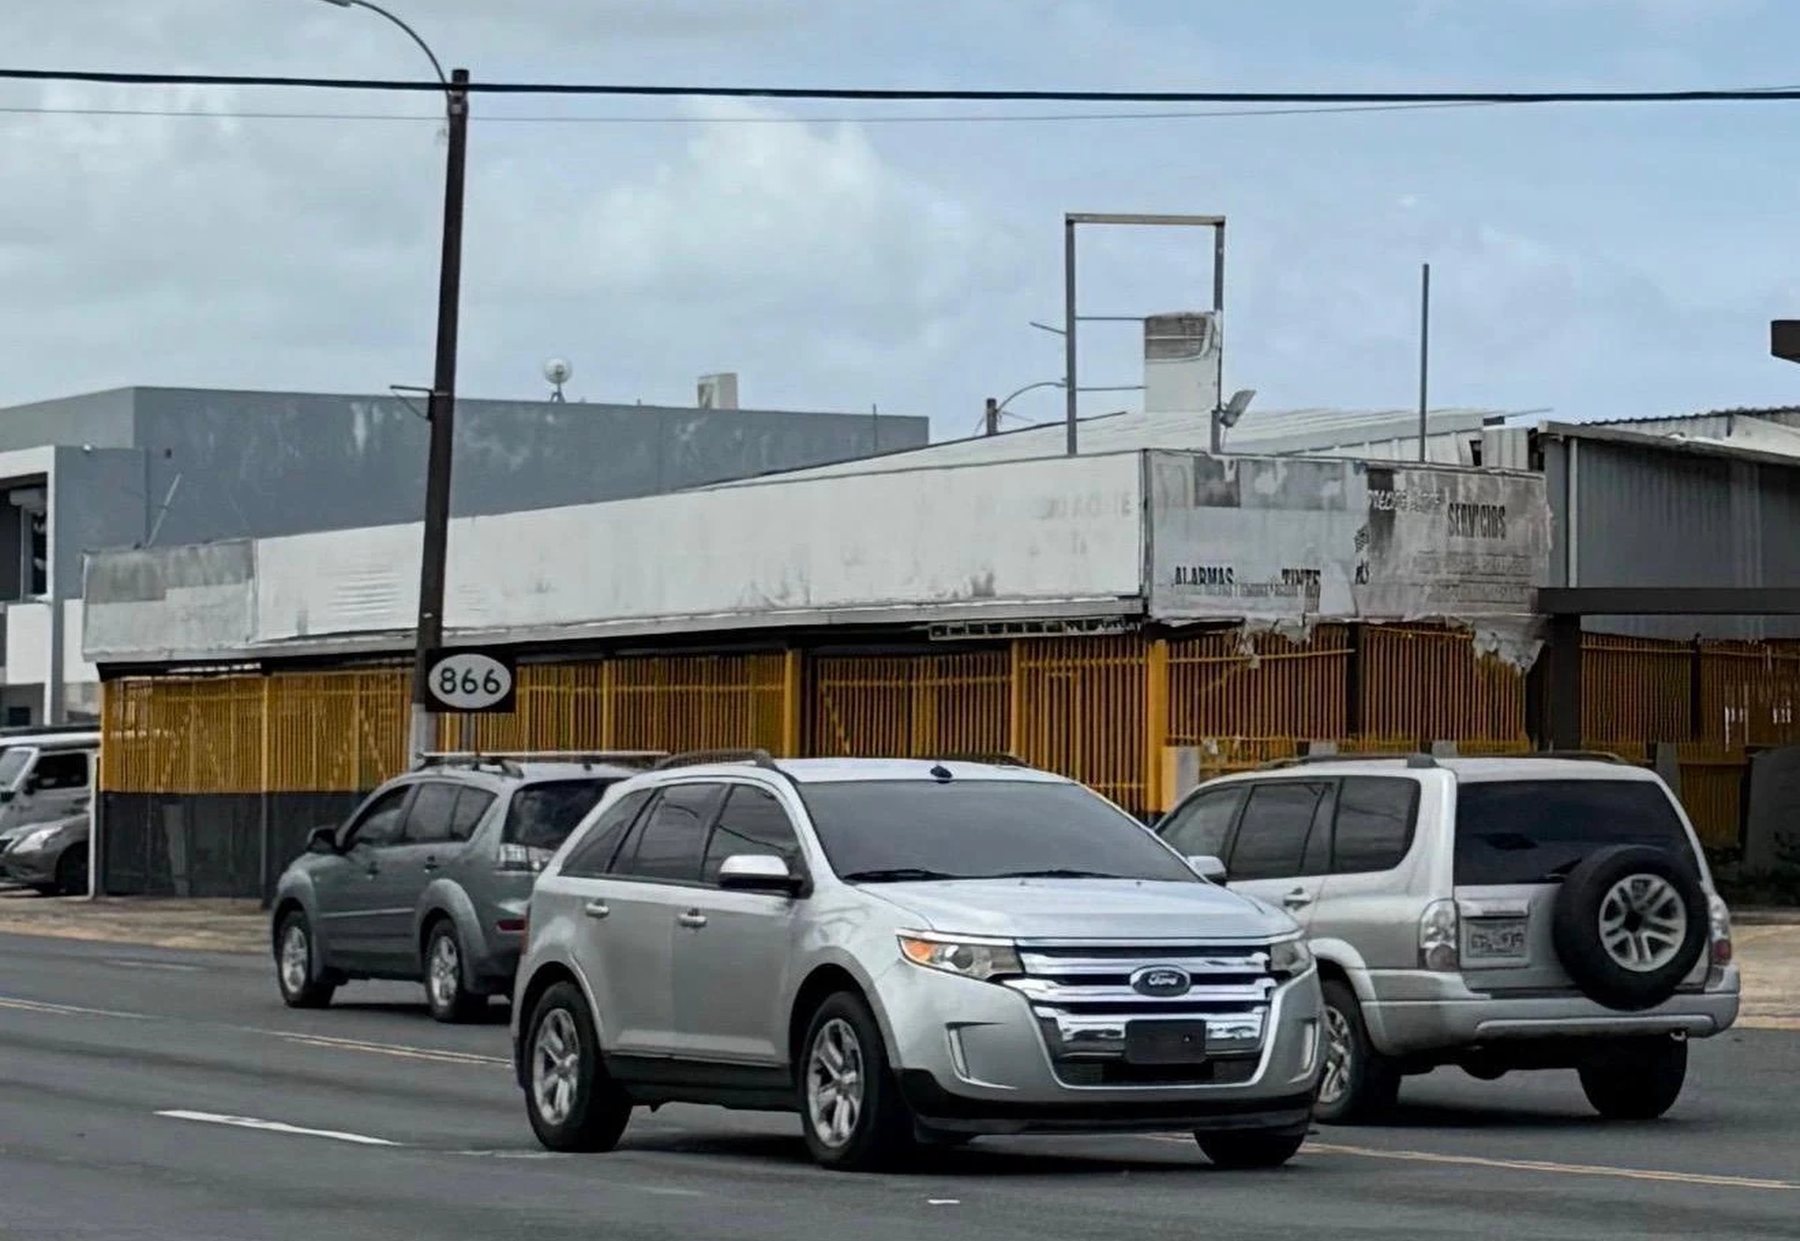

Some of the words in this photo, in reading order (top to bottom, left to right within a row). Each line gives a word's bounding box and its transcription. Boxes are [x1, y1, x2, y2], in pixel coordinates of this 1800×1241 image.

[1174, 565, 1234, 586] ALARMAS
[440, 667, 501, 695] 866
[1148, 972, 1180, 986] Ford
